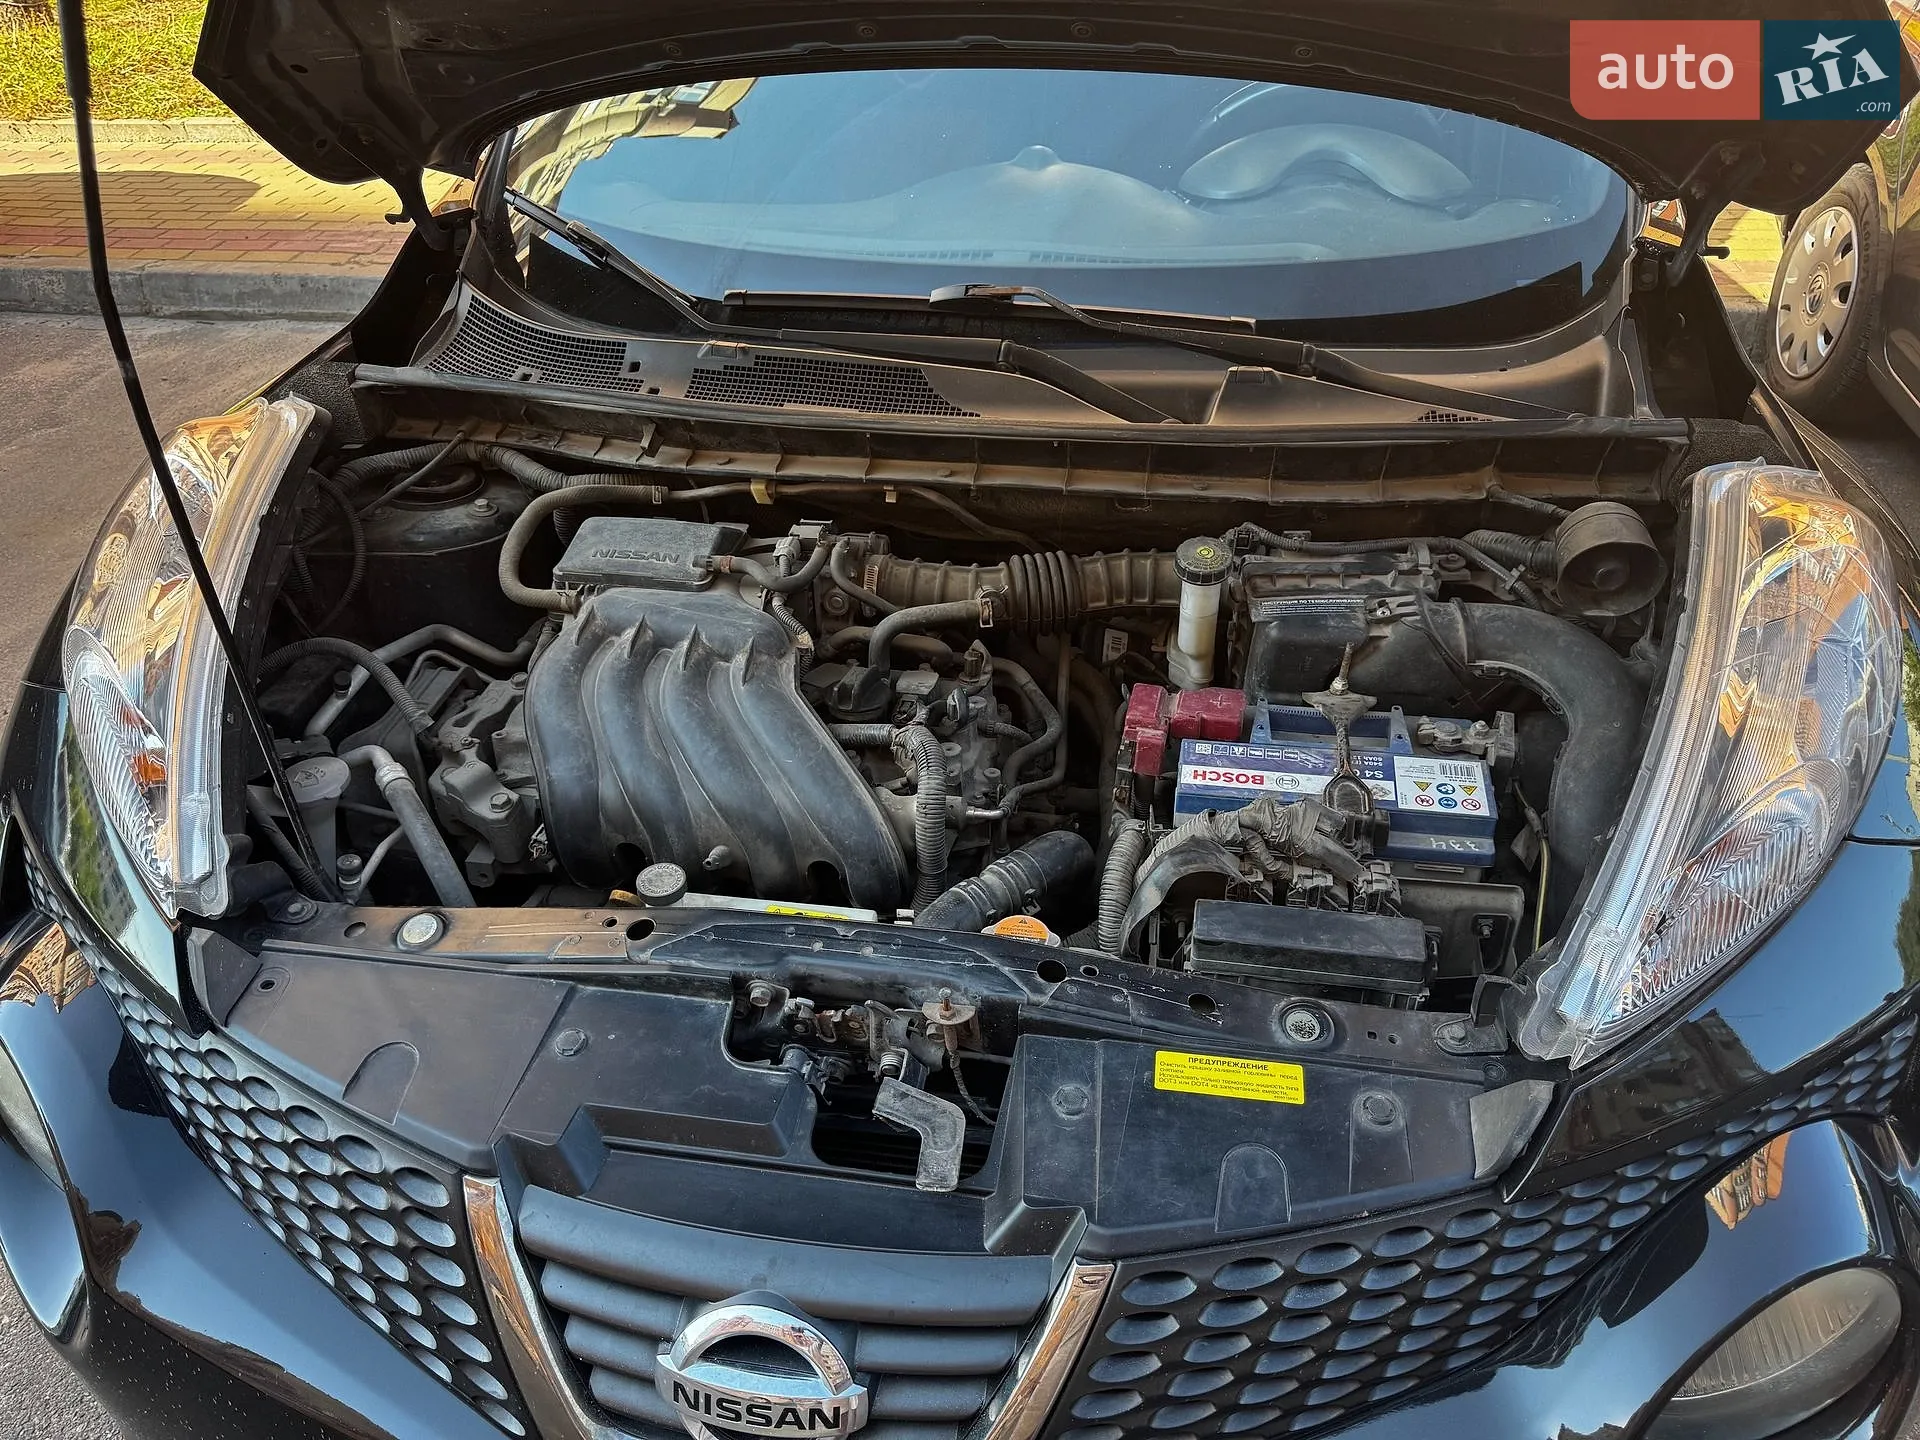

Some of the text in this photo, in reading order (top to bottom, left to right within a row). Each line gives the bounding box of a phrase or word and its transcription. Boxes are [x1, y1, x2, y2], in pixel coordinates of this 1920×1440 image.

[592, 549, 680, 564] NISSAN
[1192, 769, 1265, 787] BOSCH
[1364, 769, 1384, 778] S4
[1188, 1057, 1269, 1071] ПРЕДУПРЕЖДЕНИЕ
[672, 1380, 841, 1431] NISSAN
